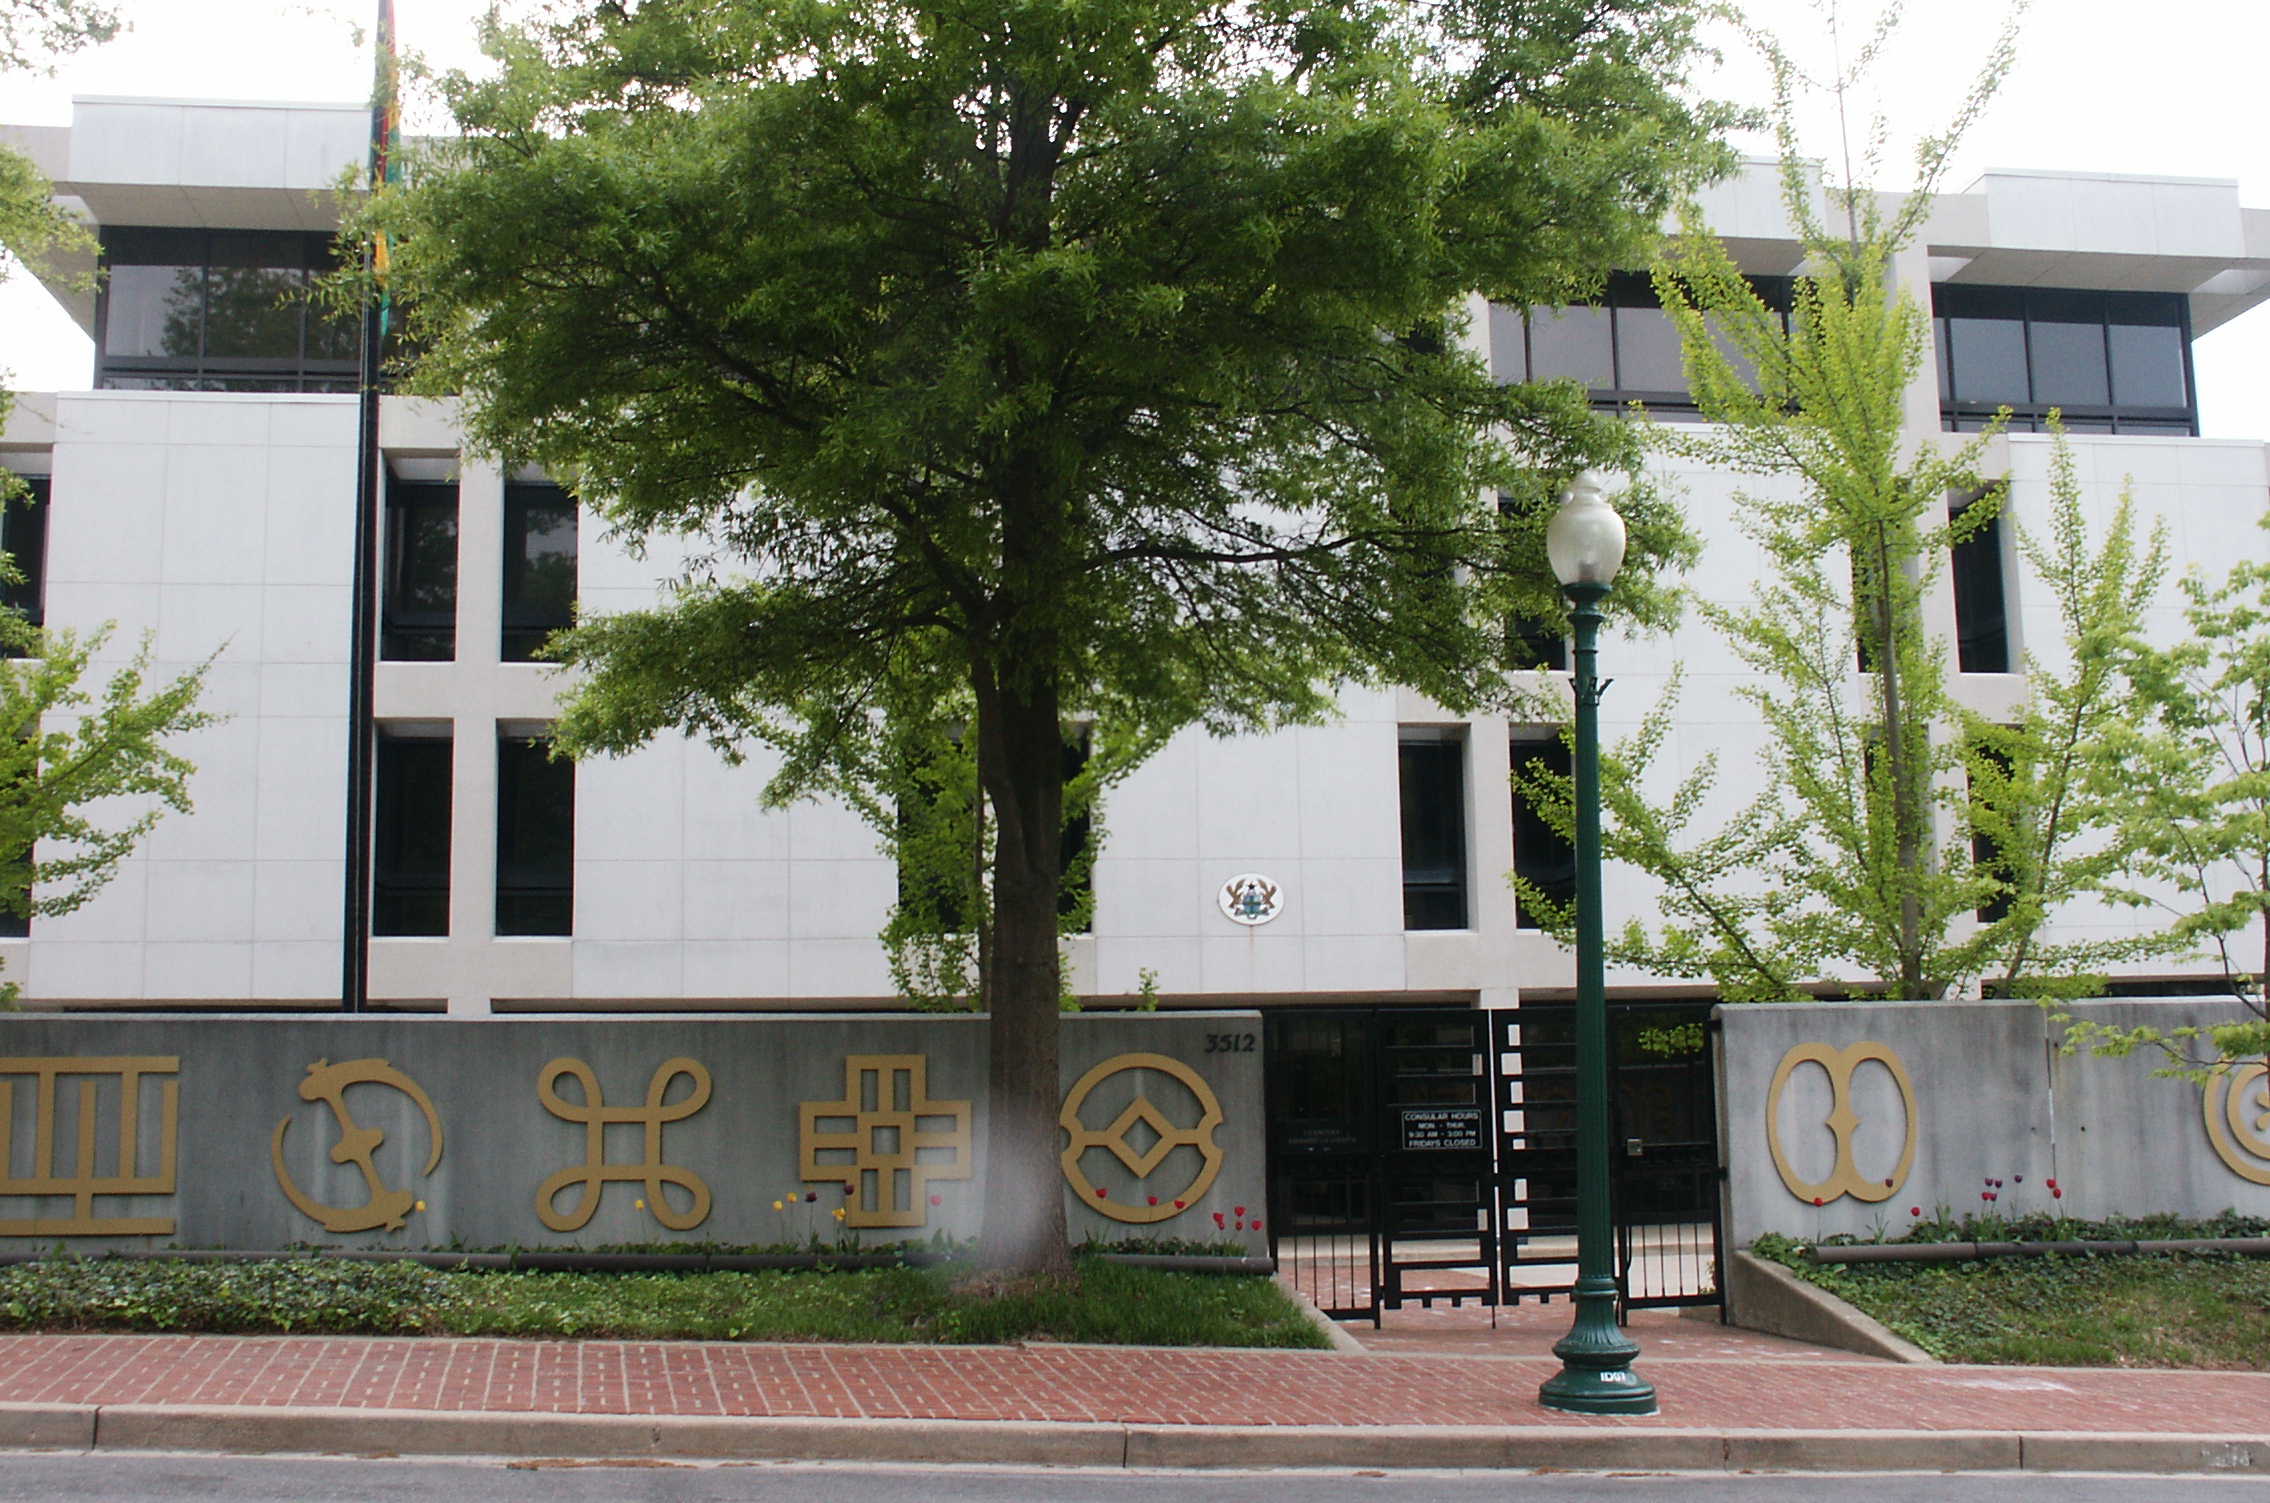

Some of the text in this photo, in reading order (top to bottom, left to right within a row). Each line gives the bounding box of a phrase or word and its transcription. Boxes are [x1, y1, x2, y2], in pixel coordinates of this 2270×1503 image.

[1204, 1033, 1256, 1053] 3512
[1404, 1112, 1479, 1121] CONSULAR HOURS
[1408, 1138, 1476, 1147] FRIDAYS CLOSED
